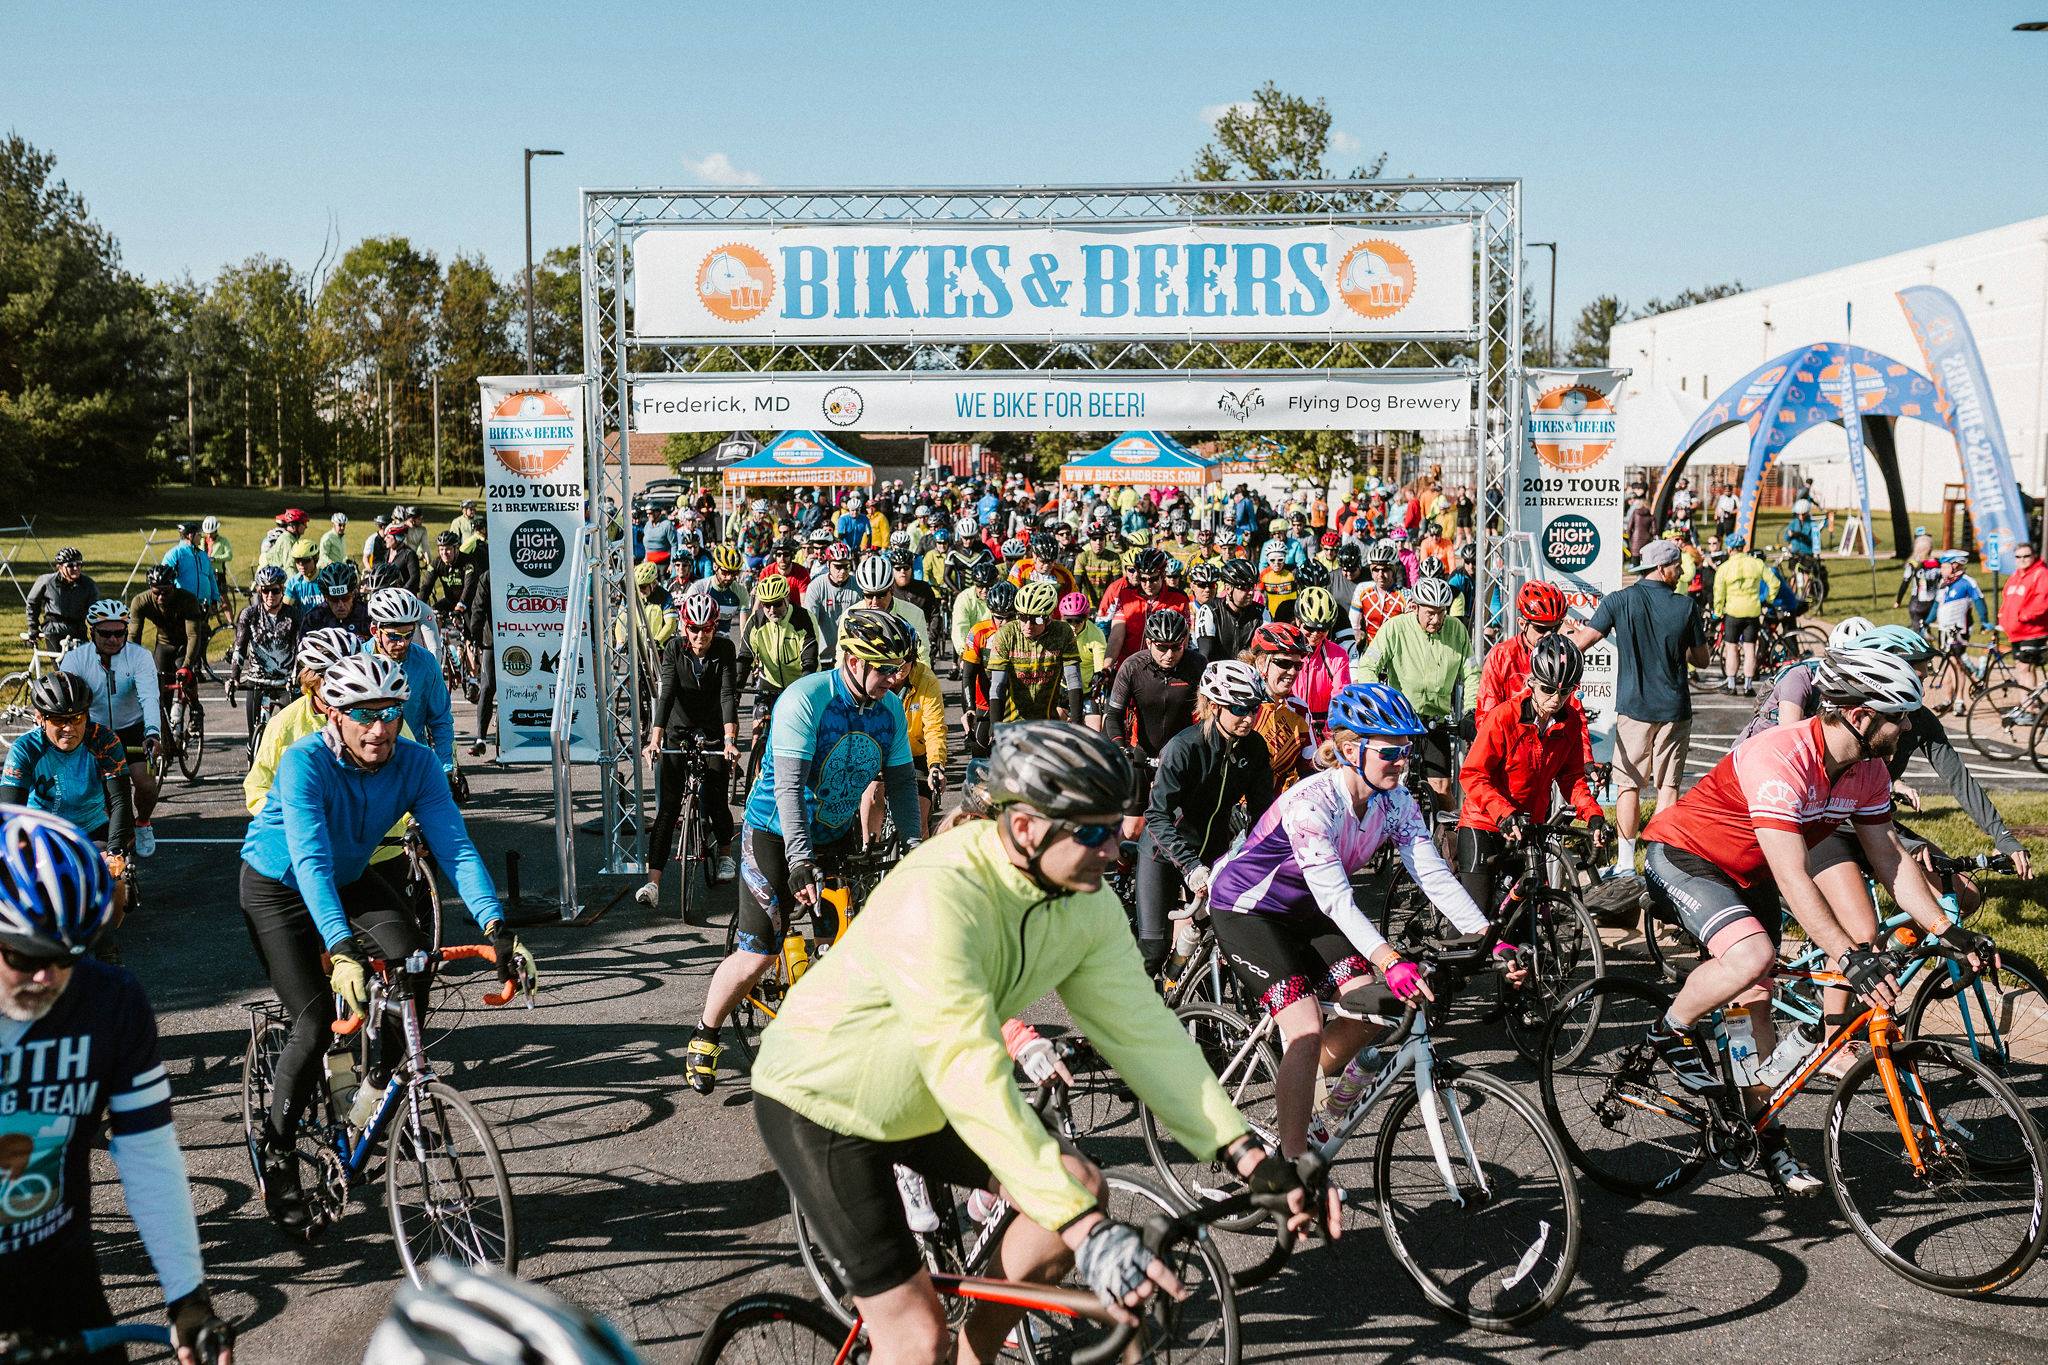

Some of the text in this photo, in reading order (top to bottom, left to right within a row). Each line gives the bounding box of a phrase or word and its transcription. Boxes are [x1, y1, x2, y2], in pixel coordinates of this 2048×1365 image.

[779, 242, 1331, 320] BIKES & BEERS
[643, 396, 790, 416] Frederick, MD
[955, 392, 1146, 417] WE BIKE FOR BEER!
[1288, 395, 1461, 412] Flying Dog Brewery
[489, 426, 574, 440] BIKES & BEERS
[1529, 420, 1615, 433] BIKES & BEERS
[728, 469, 867, 484] WWW.BIKESANDBEERS.COM
[1065, 468, 1201, 484] WWW.BIKESANDBEERS.COM
[489, 483, 582, 498] 2019 TOUR
[1523, 478, 1621, 492] 2019 TOUR
[491, 502, 579, 513] 21 BREWERIES!
[1524, 497, 1618, 507] 21 BREWERIES!
[516, 534, 558, 548] HIGH
[1549, 529, 1594, 543] HIGH
[516, 549, 559, 563] Brew
[1548, 543, 1594, 558] Brew
[523, 562, 552, 570] COFFEE
[1555, 557, 1586, 565] COFFEE
[503, 661, 532, 671] Hubs
[1583, 654, 1611, 666] REI
[505, 688, 538, 703] Mondays
[1581, 685, 1611, 697] PPEAS
[1667, 884, 1702, 913] HARDWARE
[0, 1035, 91, 1084] OTH
[28, 1081, 99, 1116] TEAM
